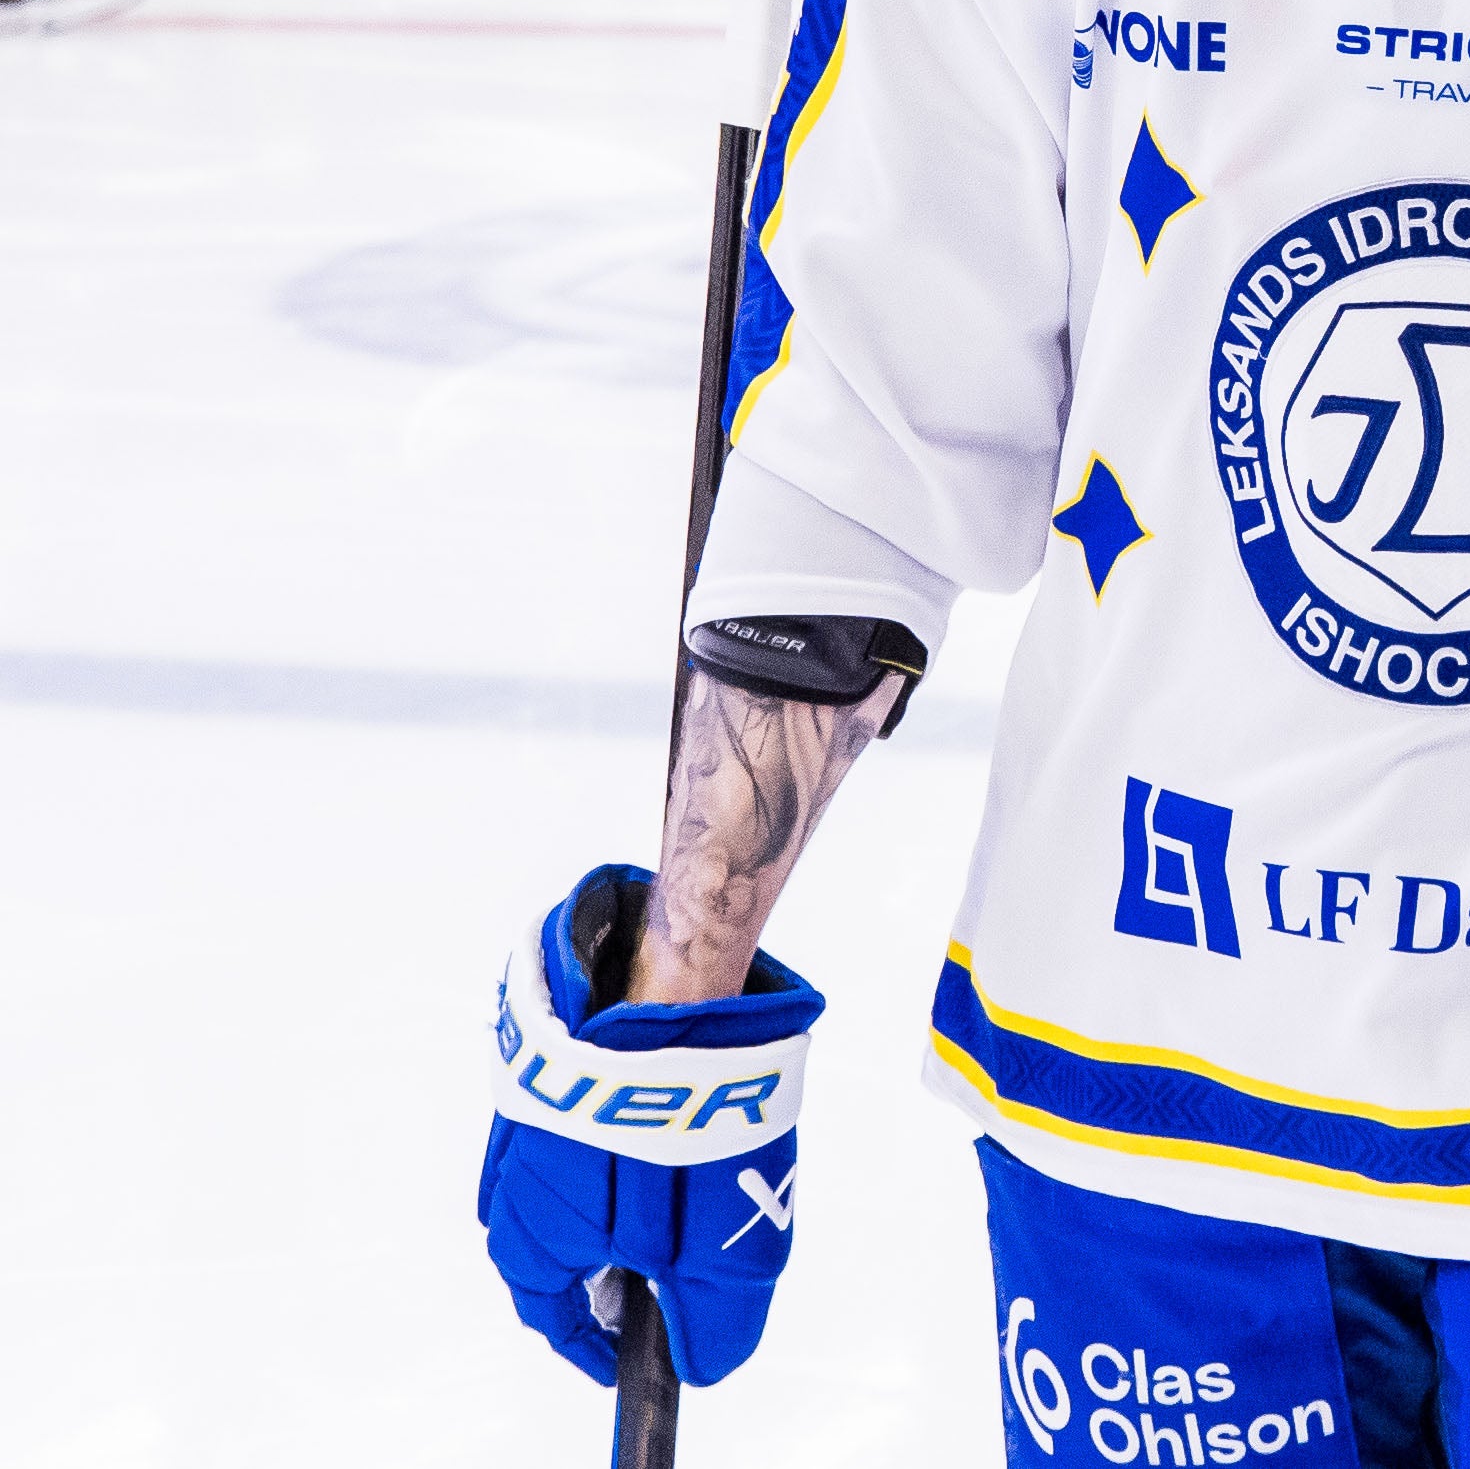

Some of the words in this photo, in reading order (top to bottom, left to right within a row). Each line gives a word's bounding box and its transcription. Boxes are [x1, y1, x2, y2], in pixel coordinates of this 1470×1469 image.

[1215, 237, 1327, 544] LEKSANDS
[1261, 861, 1371, 944] LF
[1080, 1341, 1236, 1406] Clas
[1088, 1398, 1336, 1467] Ohlson
